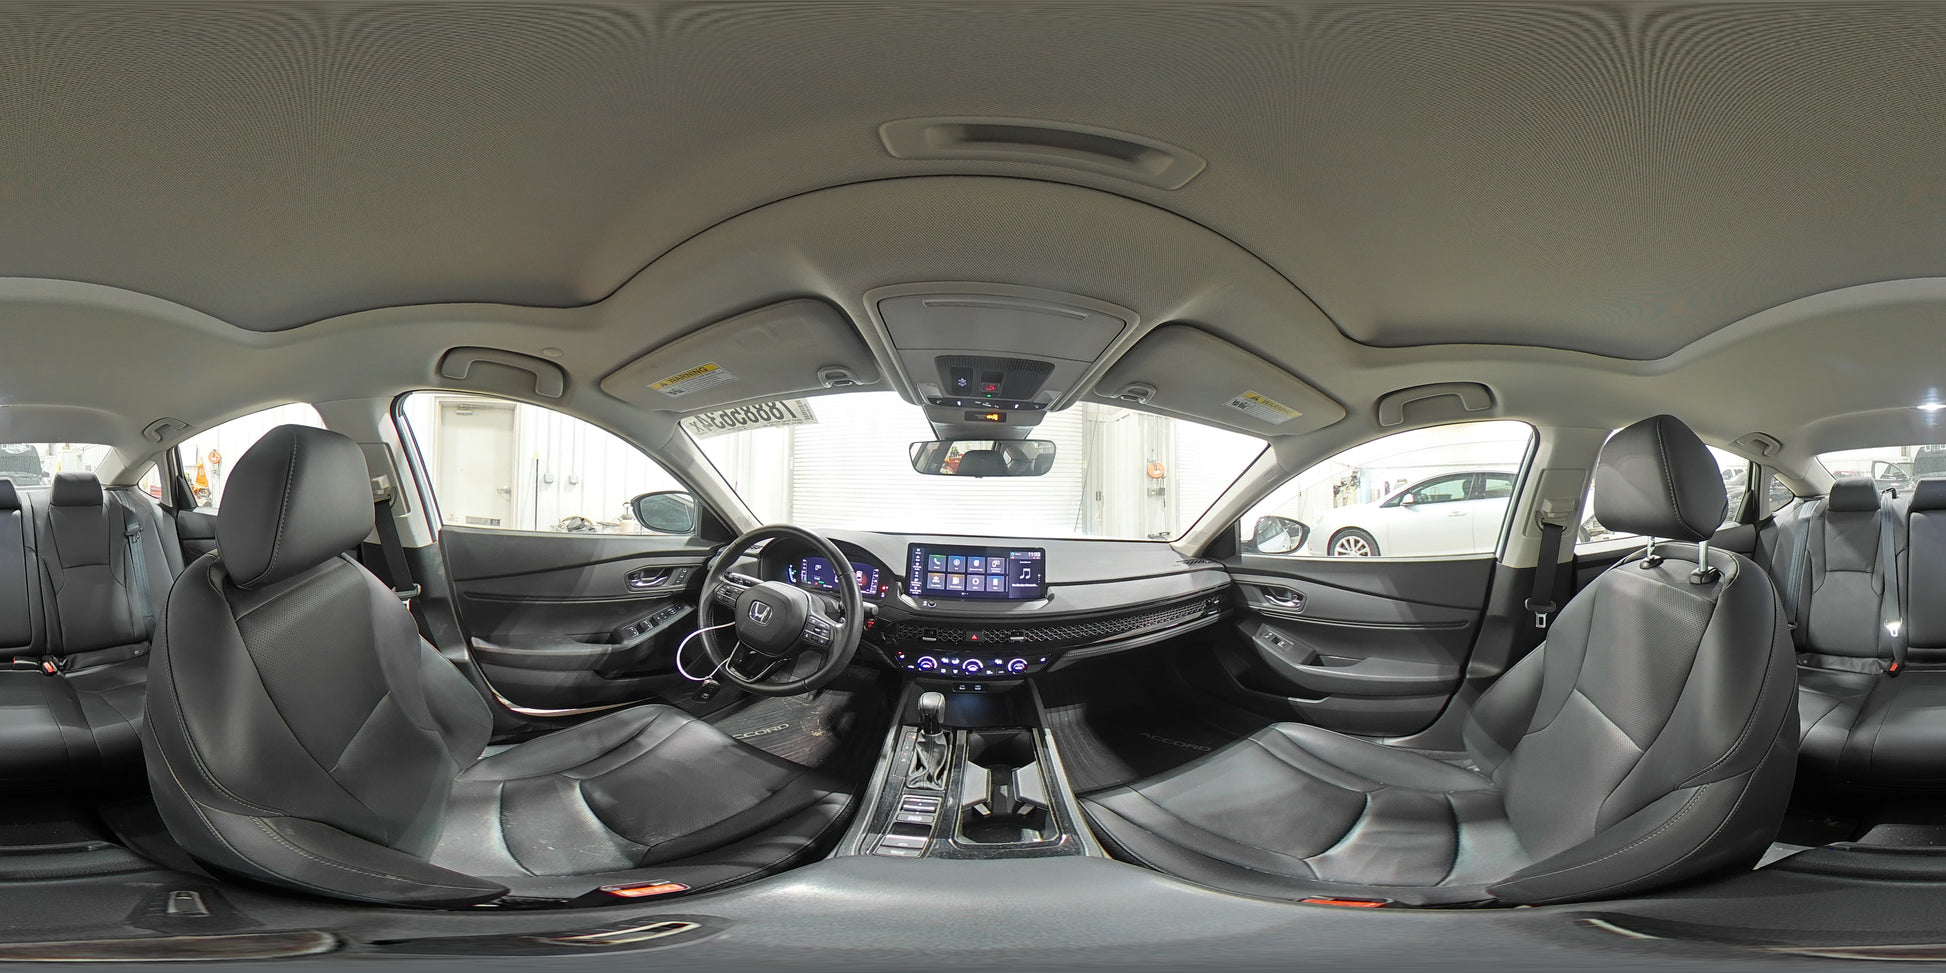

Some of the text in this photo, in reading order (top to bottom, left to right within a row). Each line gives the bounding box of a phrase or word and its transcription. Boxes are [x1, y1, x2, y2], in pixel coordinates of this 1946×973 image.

[669, 366, 708, 383] WARNING
[1262, 399, 1294, 415] WARNING
[732, 723, 789, 740] CCORD
[1136, 732, 1212, 752] ACCORD
